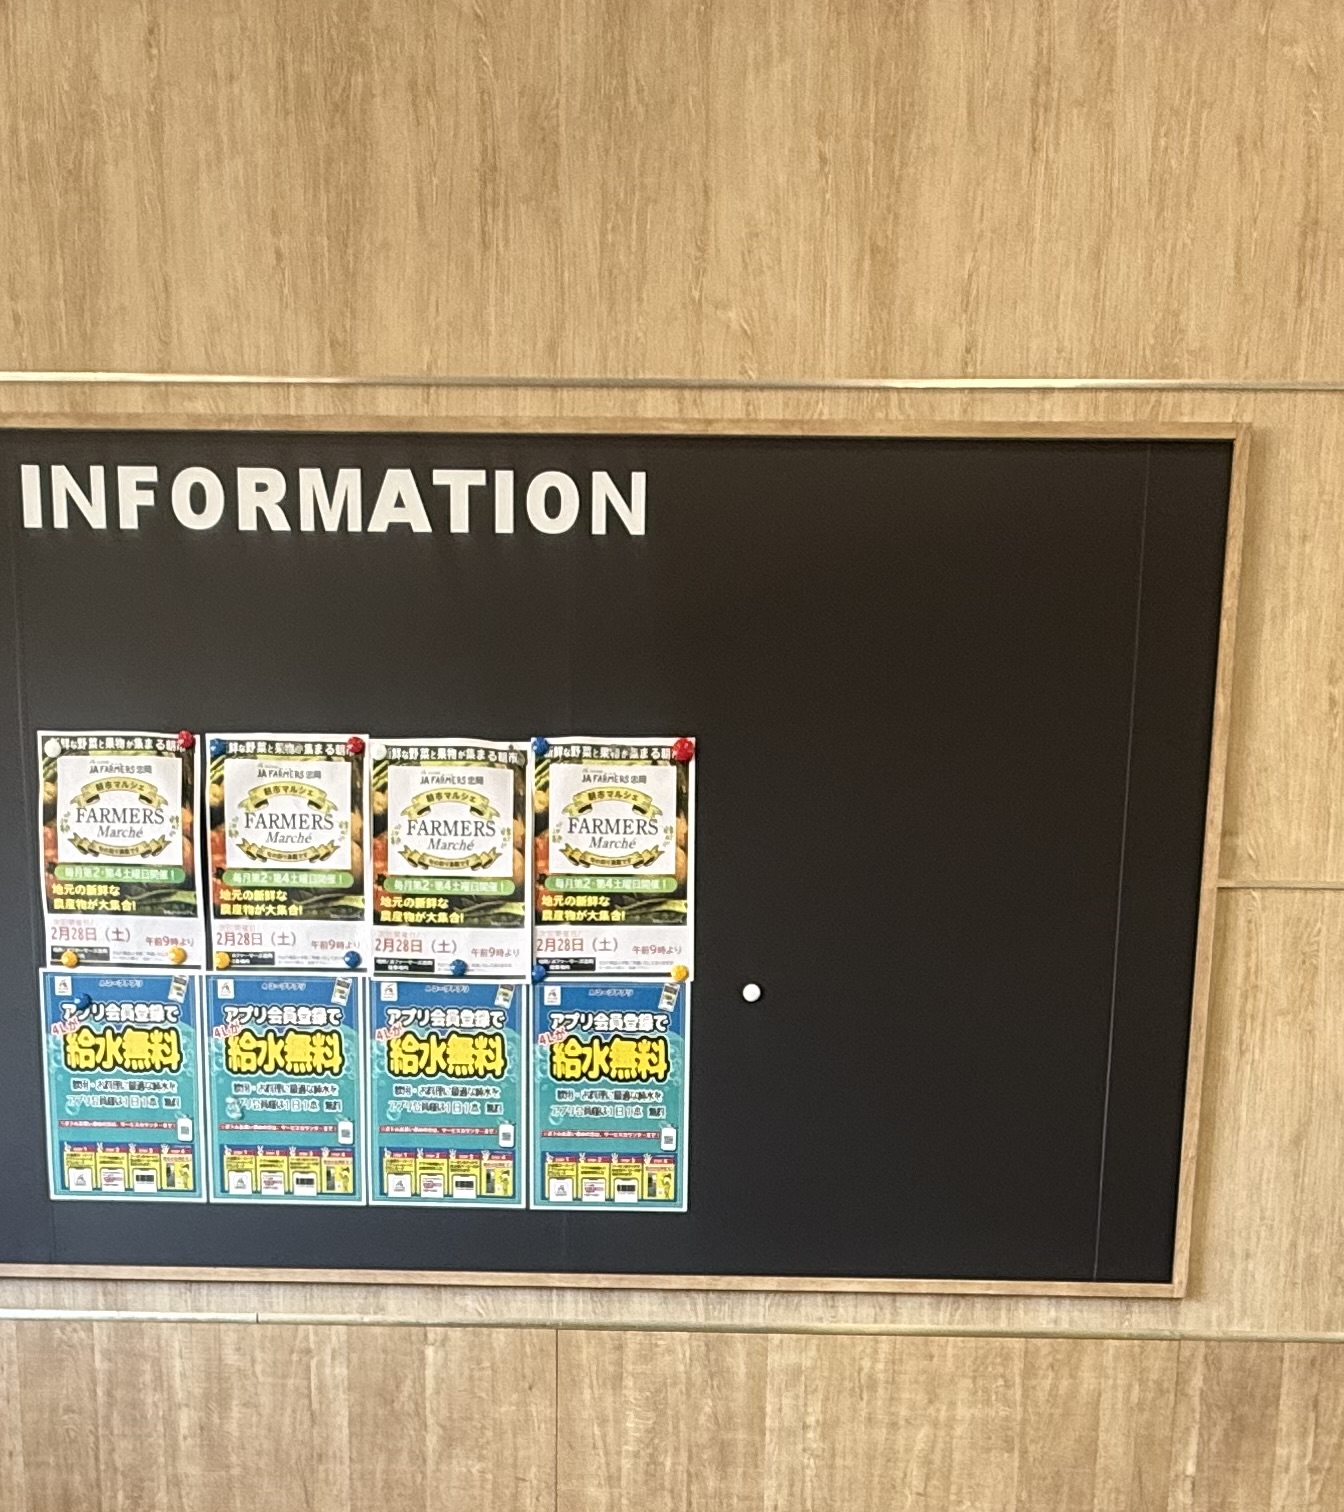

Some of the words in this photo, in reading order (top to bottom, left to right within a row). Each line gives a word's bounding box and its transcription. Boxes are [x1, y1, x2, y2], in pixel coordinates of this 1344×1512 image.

[21, 464, 647, 535] INFORMATION
[50, 737, 186, 752] 鮮な野菜と果物が集まる朝
[228, 741, 355, 756] 鮮な野菜と果物が集まる朝
[389, 747, 518, 764] 鮮な野菜と果物が集まる朝市
[544, 746, 678, 760] 鮮な野菜と果物が集まる朝
[76, 808, 165, 824] FARMERS
[244, 812, 334, 830] FARMERS
[97, 825, 143, 838] Marché
[407, 820, 496, 837] FARMERS
[568, 818, 659, 835] FARMERS
[265, 831, 312, 844] Marché
[427, 838, 475, 851] Marché
[589, 836, 636, 849] Marché
[52, 884, 121, 896] 地元の新鮮な
[219, 889, 288, 902] 地元の新鮮な
[380, 896, 449, 909] 地元の新鮮な
[541, 895, 610, 907] 地元の新鮮な
[146, 936, 194, 947] 午前9時より
[311, 939, 360, 950] 午前9時より
[471, 947, 520, 957] 午前9時より
[632, 944, 682, 955] 午前9時より
[224, 1005, 344, 1025] アプリ会員登録で
[386, 1009, 506, 1028] アプリ会員登録で
[549, 1012, 669, 1032] アプリ会員登録で
[65, 1027, 181, 1070] 給水無料
[227, 1031, 343, 1073] 給水無料
[389, 1033, 505, 1076] 給水無料
[552, 1037, 668, 1080] 給水無料
